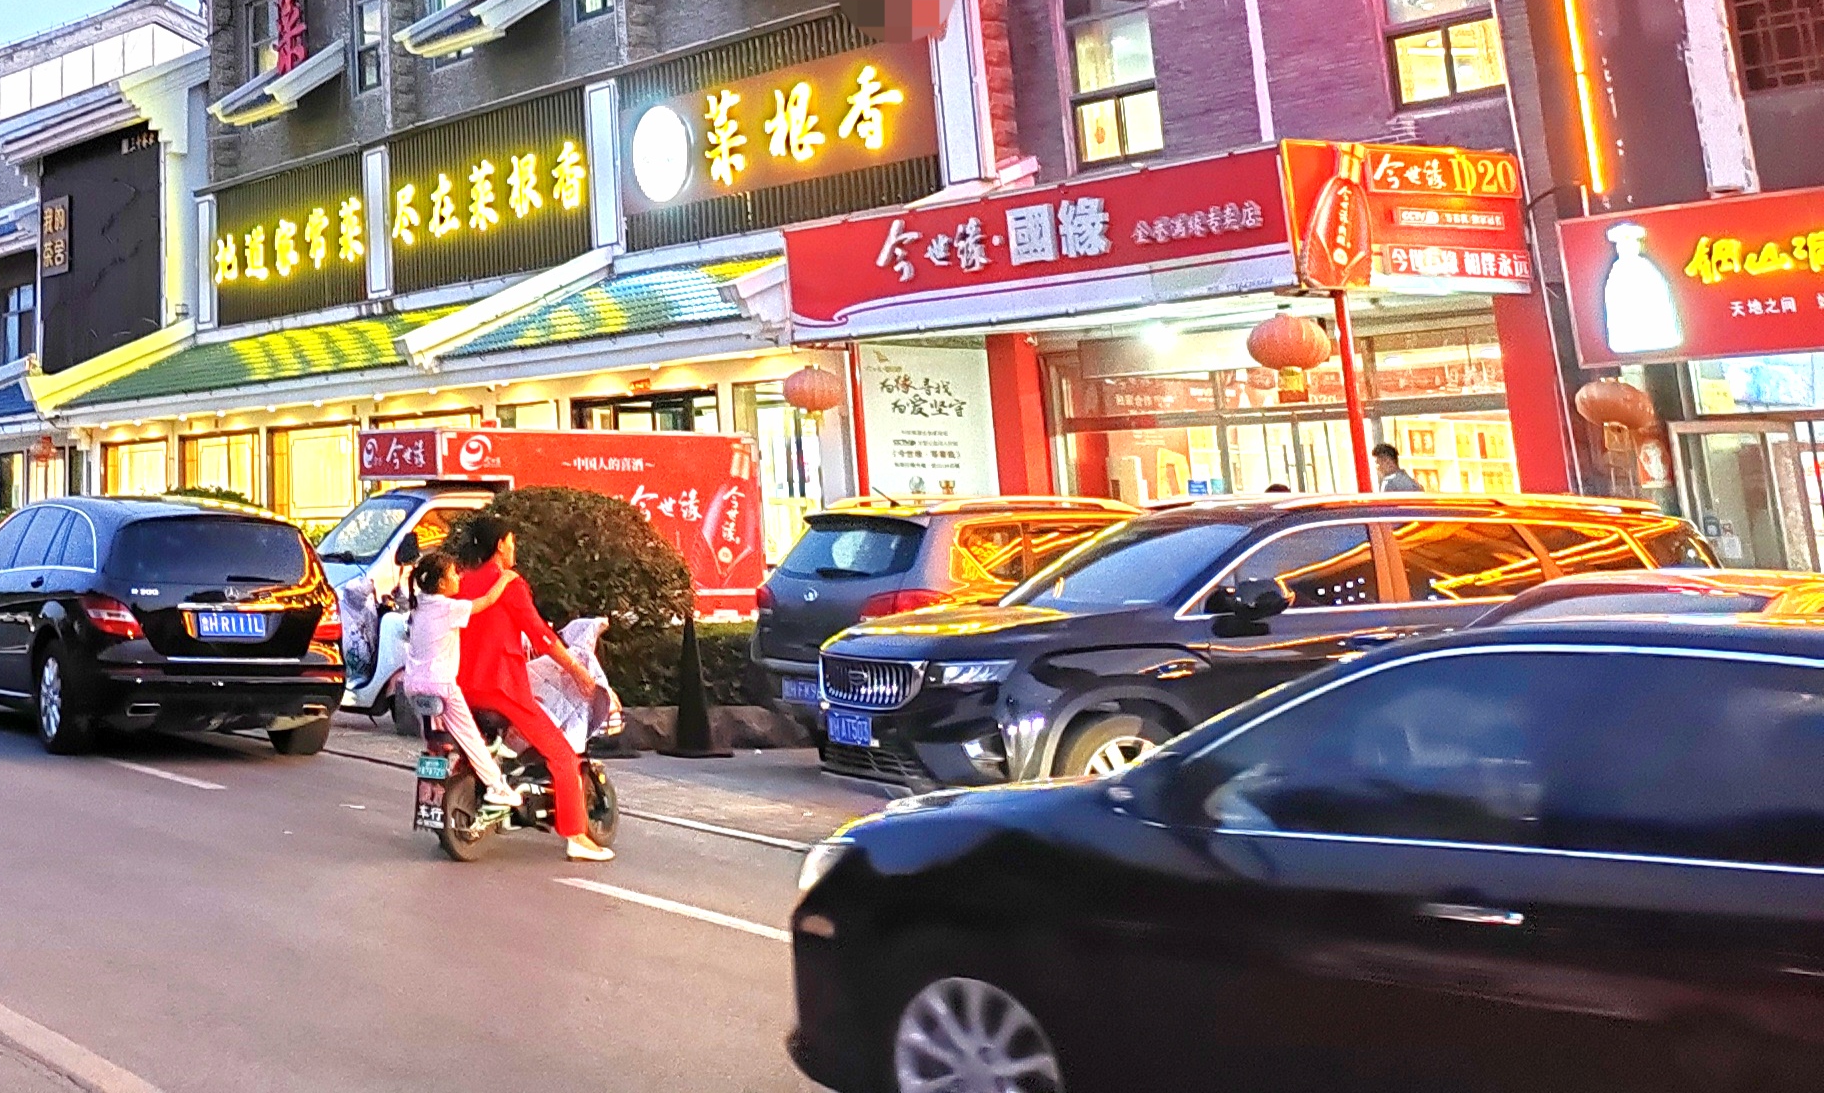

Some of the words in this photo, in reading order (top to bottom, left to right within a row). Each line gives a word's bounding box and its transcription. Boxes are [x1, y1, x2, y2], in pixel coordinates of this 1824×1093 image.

[704, 65, 904, 186] 菜根香
[215, 197, 365, 283] 地道家常菜
[392, 141, 586, 245] 尽在菜根香
[1730, 296, 1797, 317] 天地之间
[386, 437, 426, 469] 今世缘
[630, 485, 702, 522] 今世缘
